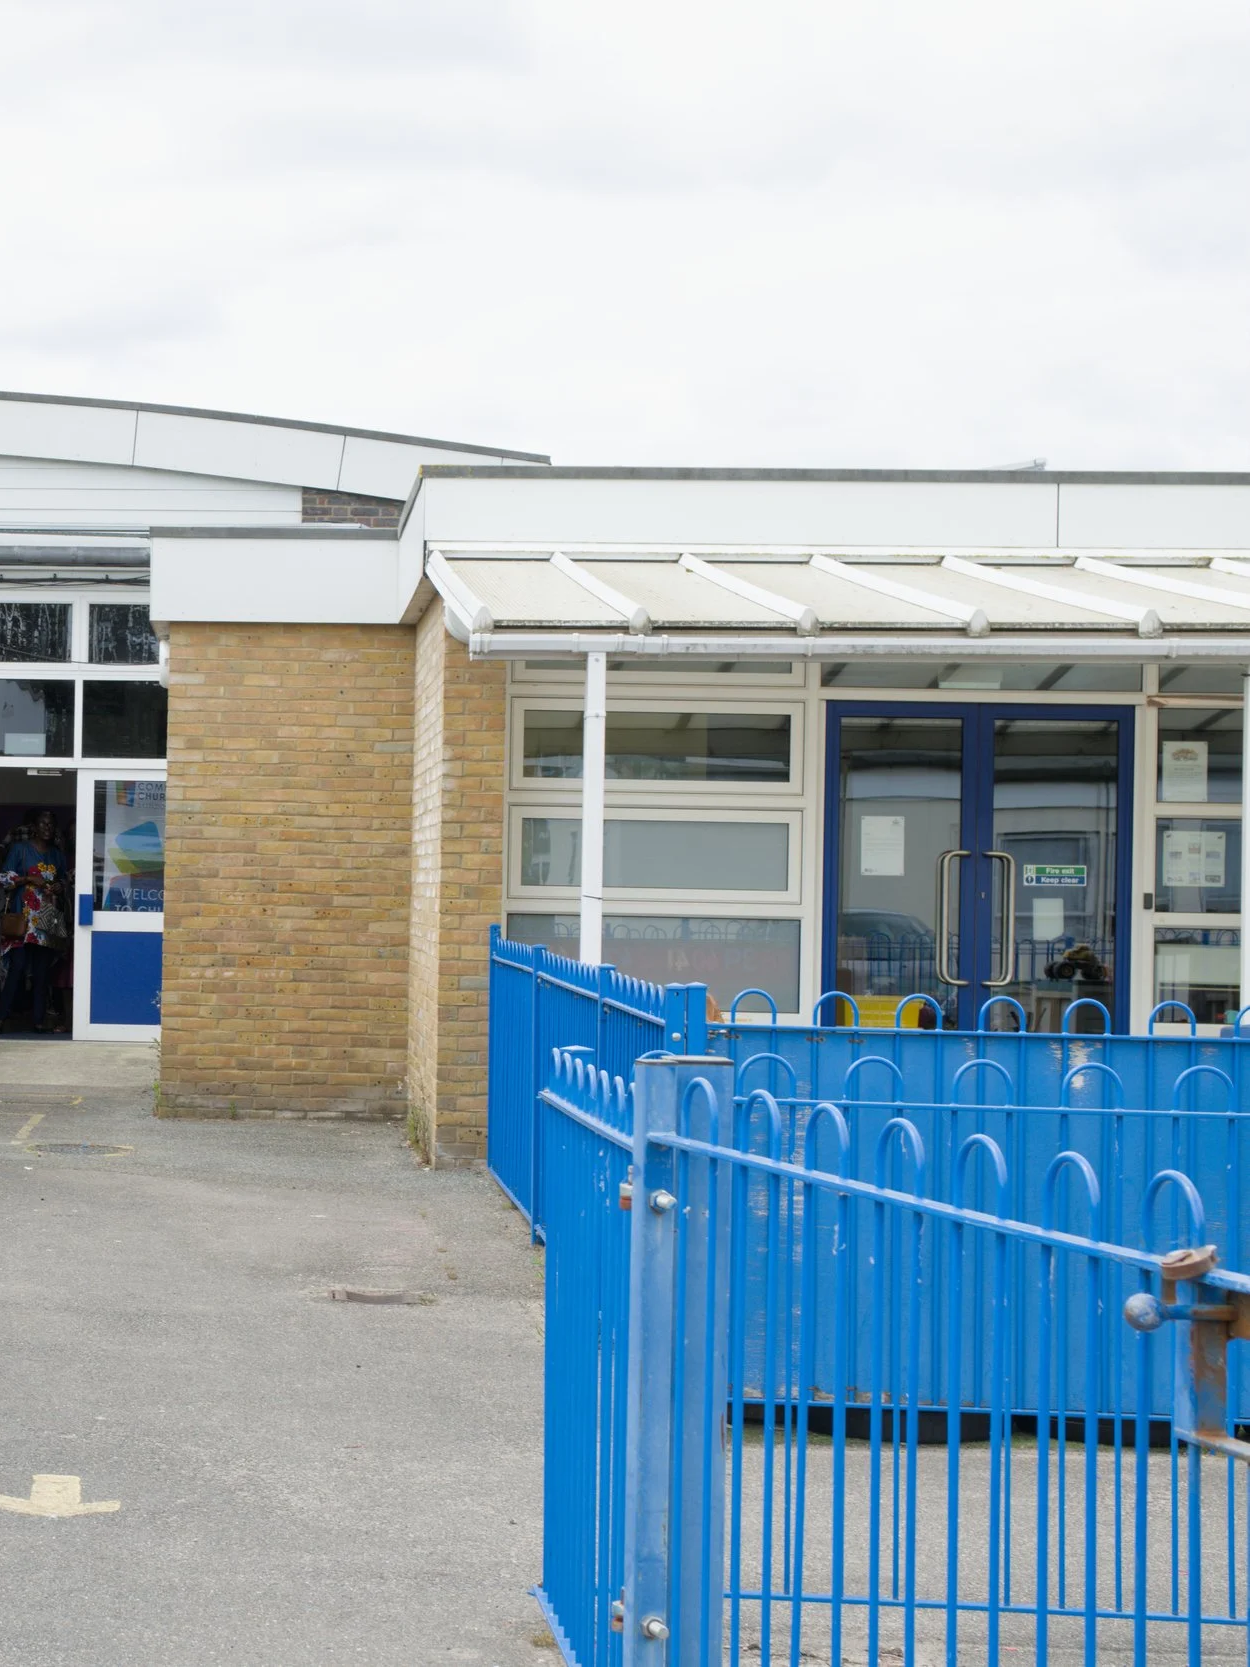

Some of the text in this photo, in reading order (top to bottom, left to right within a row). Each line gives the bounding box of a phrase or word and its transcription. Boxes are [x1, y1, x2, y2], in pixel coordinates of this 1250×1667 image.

[138, 782, 166, 792] COM
[1040, 876, 1079, 884] Keep clear
